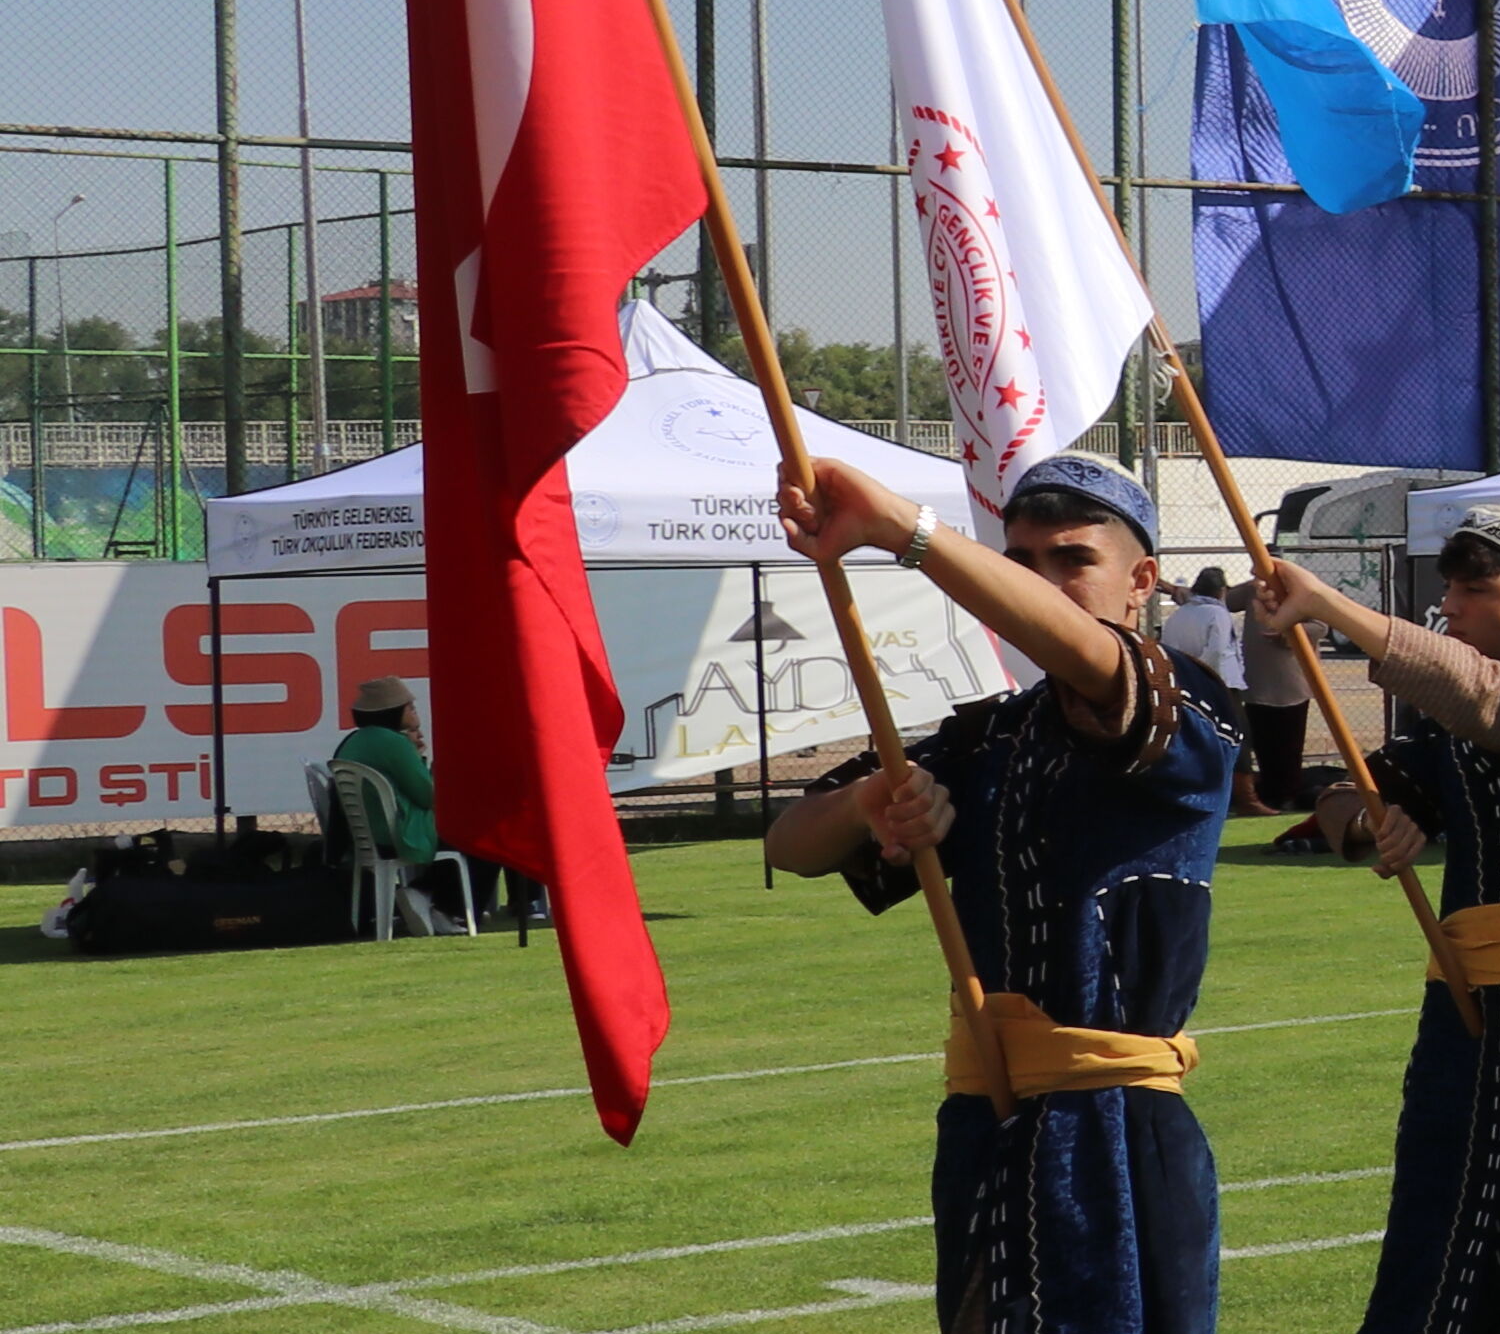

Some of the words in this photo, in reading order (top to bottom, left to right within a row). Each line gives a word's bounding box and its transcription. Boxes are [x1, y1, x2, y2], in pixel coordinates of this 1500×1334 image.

[939, 204, 996, 305] GENÇLİK
[973, 312, 995, 346] VE
[691, 495, 779, 516] TÜRKİYE
[293, 508, 341, 530] TÜRKİYE
[343, 506, 414, 526] GELENEKSEL
[648, 520, 705, 541] TÜRK
[272, 535, 300, 556] TÜRK
[301, 533, 354, 556] OKÇULUK
[99, 753, 212, 807] ŞTİ
